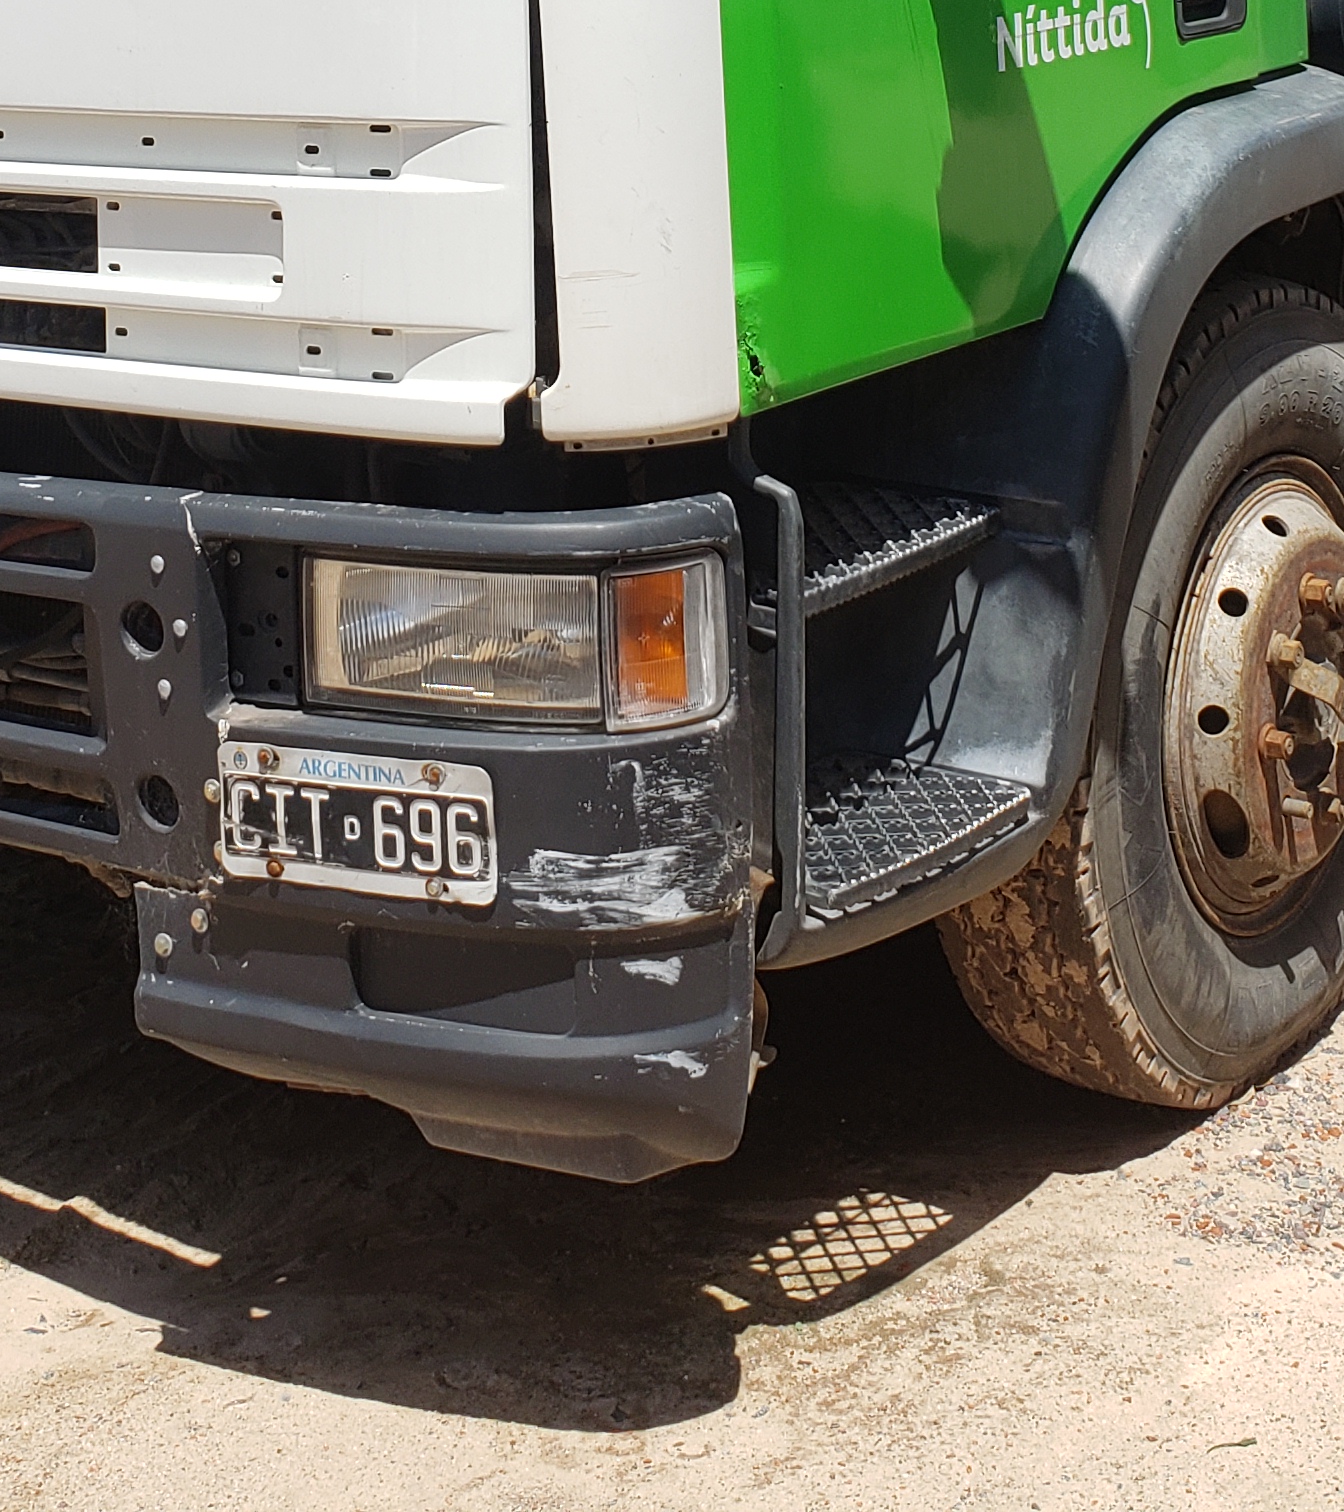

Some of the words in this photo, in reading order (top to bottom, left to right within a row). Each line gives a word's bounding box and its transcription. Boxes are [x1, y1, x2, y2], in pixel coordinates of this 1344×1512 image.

[299, 756, 406, 786] ARGENTINA
[230, 779, 330, 864] CIT
[343, 814, 362, 841] D
[372, 794, 483, 877] 696
